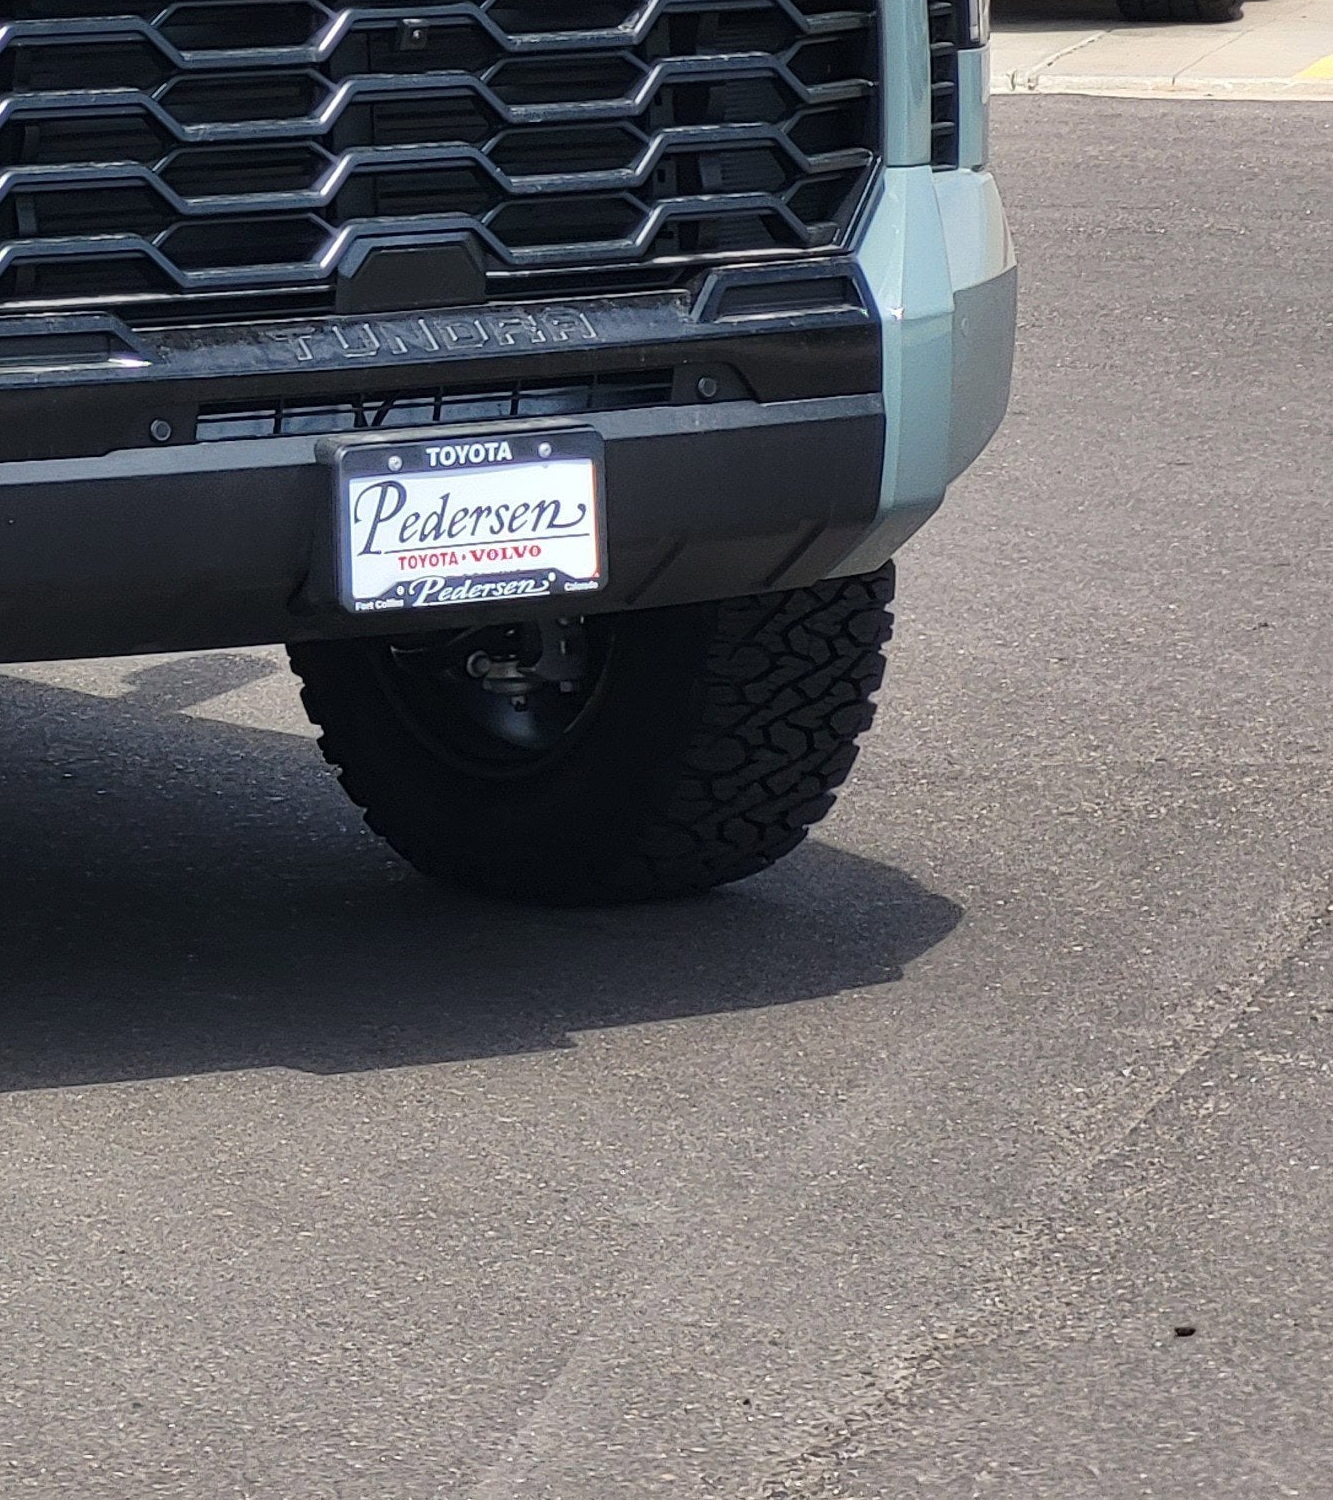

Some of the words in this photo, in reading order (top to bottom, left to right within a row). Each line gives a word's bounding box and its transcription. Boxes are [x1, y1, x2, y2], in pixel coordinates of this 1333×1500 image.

[268, 307, 597, 361] TUNDRA
[426, 441, 513, 467] TOYOTA
[353, 480, 587, 556] Pedersen
[398, 551, 459, 570] TOYOTA
[469, 545, 542, 563] VOLVO
[409, 575, 550, 607] Pedersen
